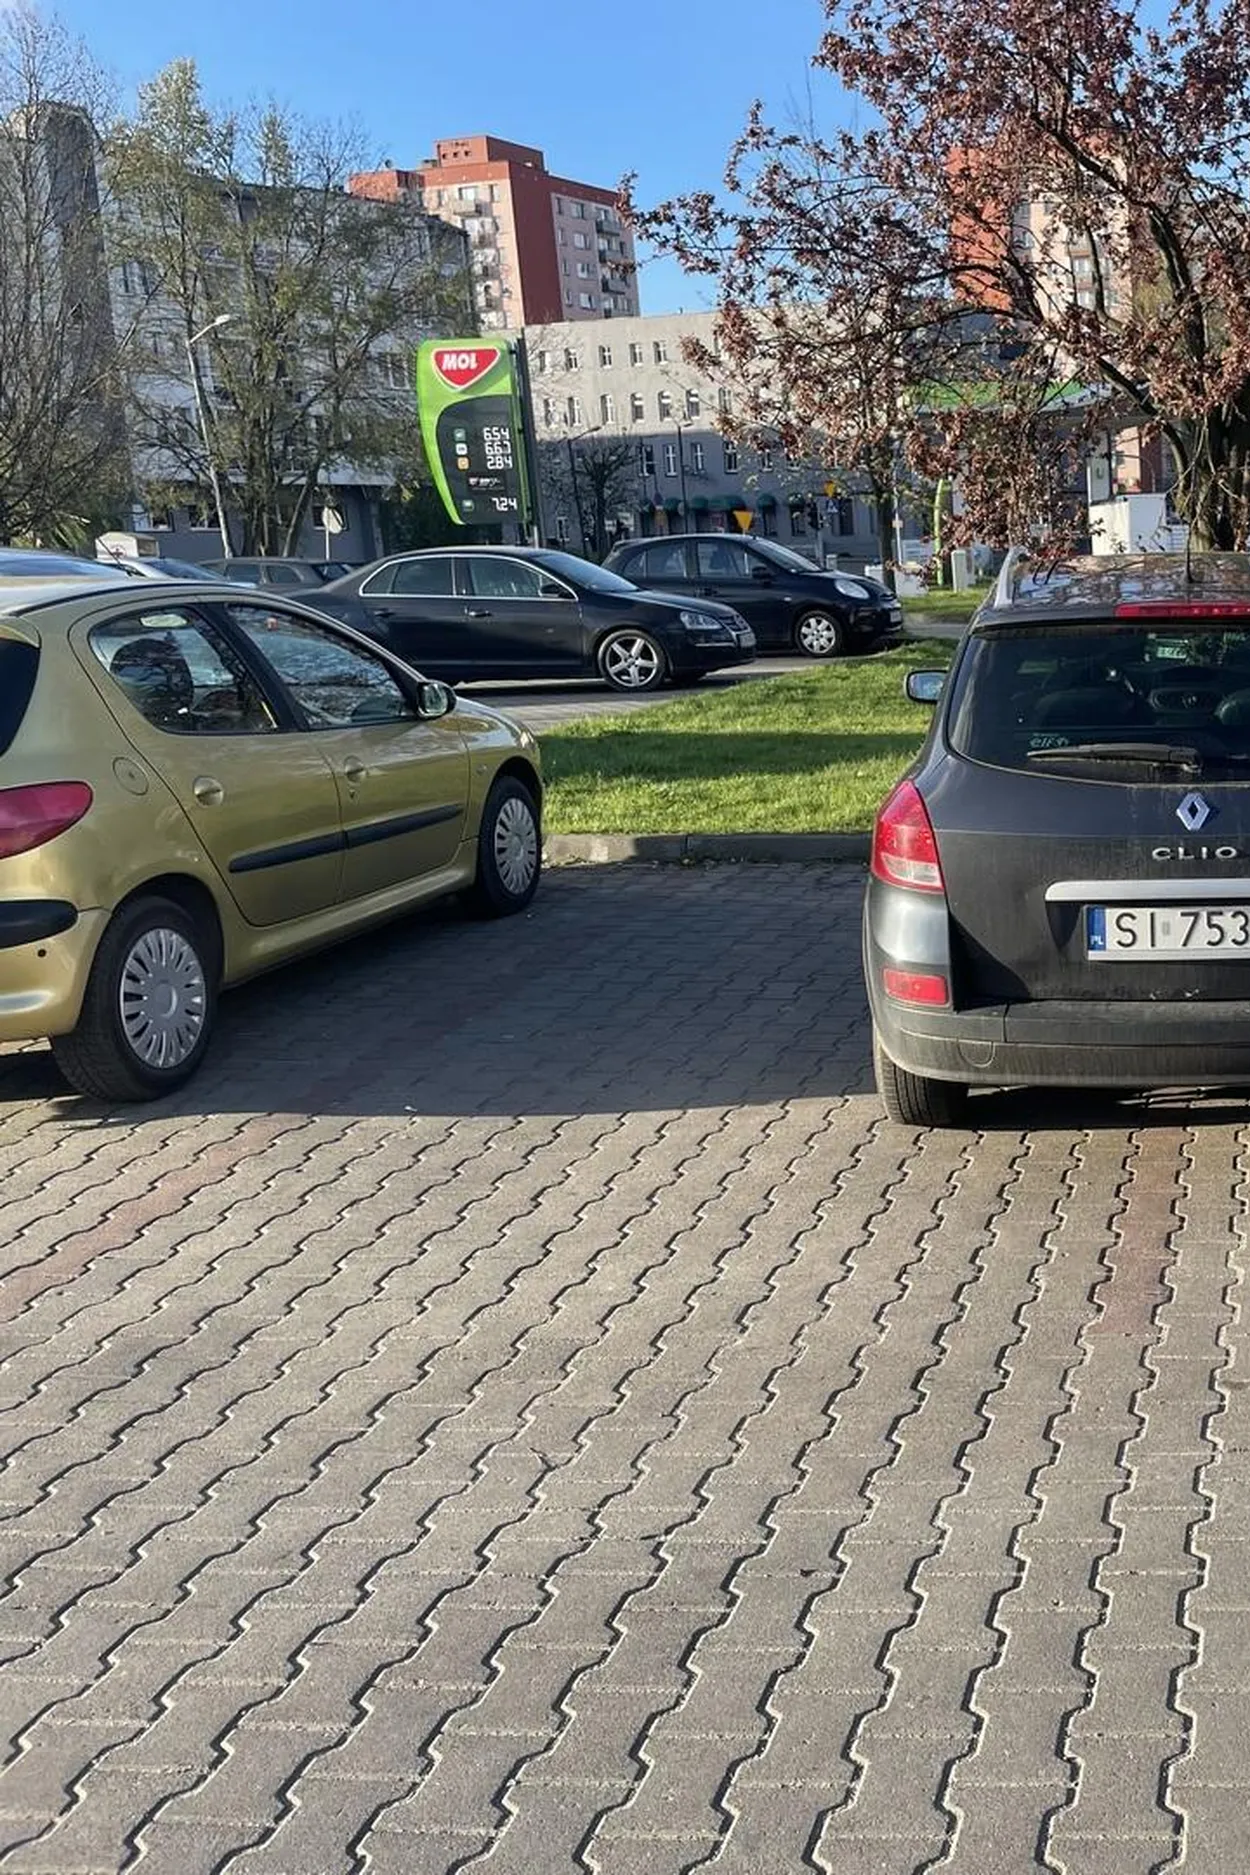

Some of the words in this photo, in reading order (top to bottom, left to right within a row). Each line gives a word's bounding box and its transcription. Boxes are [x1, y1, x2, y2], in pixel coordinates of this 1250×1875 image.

[441, 352, 478, 371] MOL
[1152, 846, 1237, 860] CLIO
[1115, 911, 1156, 948] SI
[1090, 935, 1104, 945] PL
